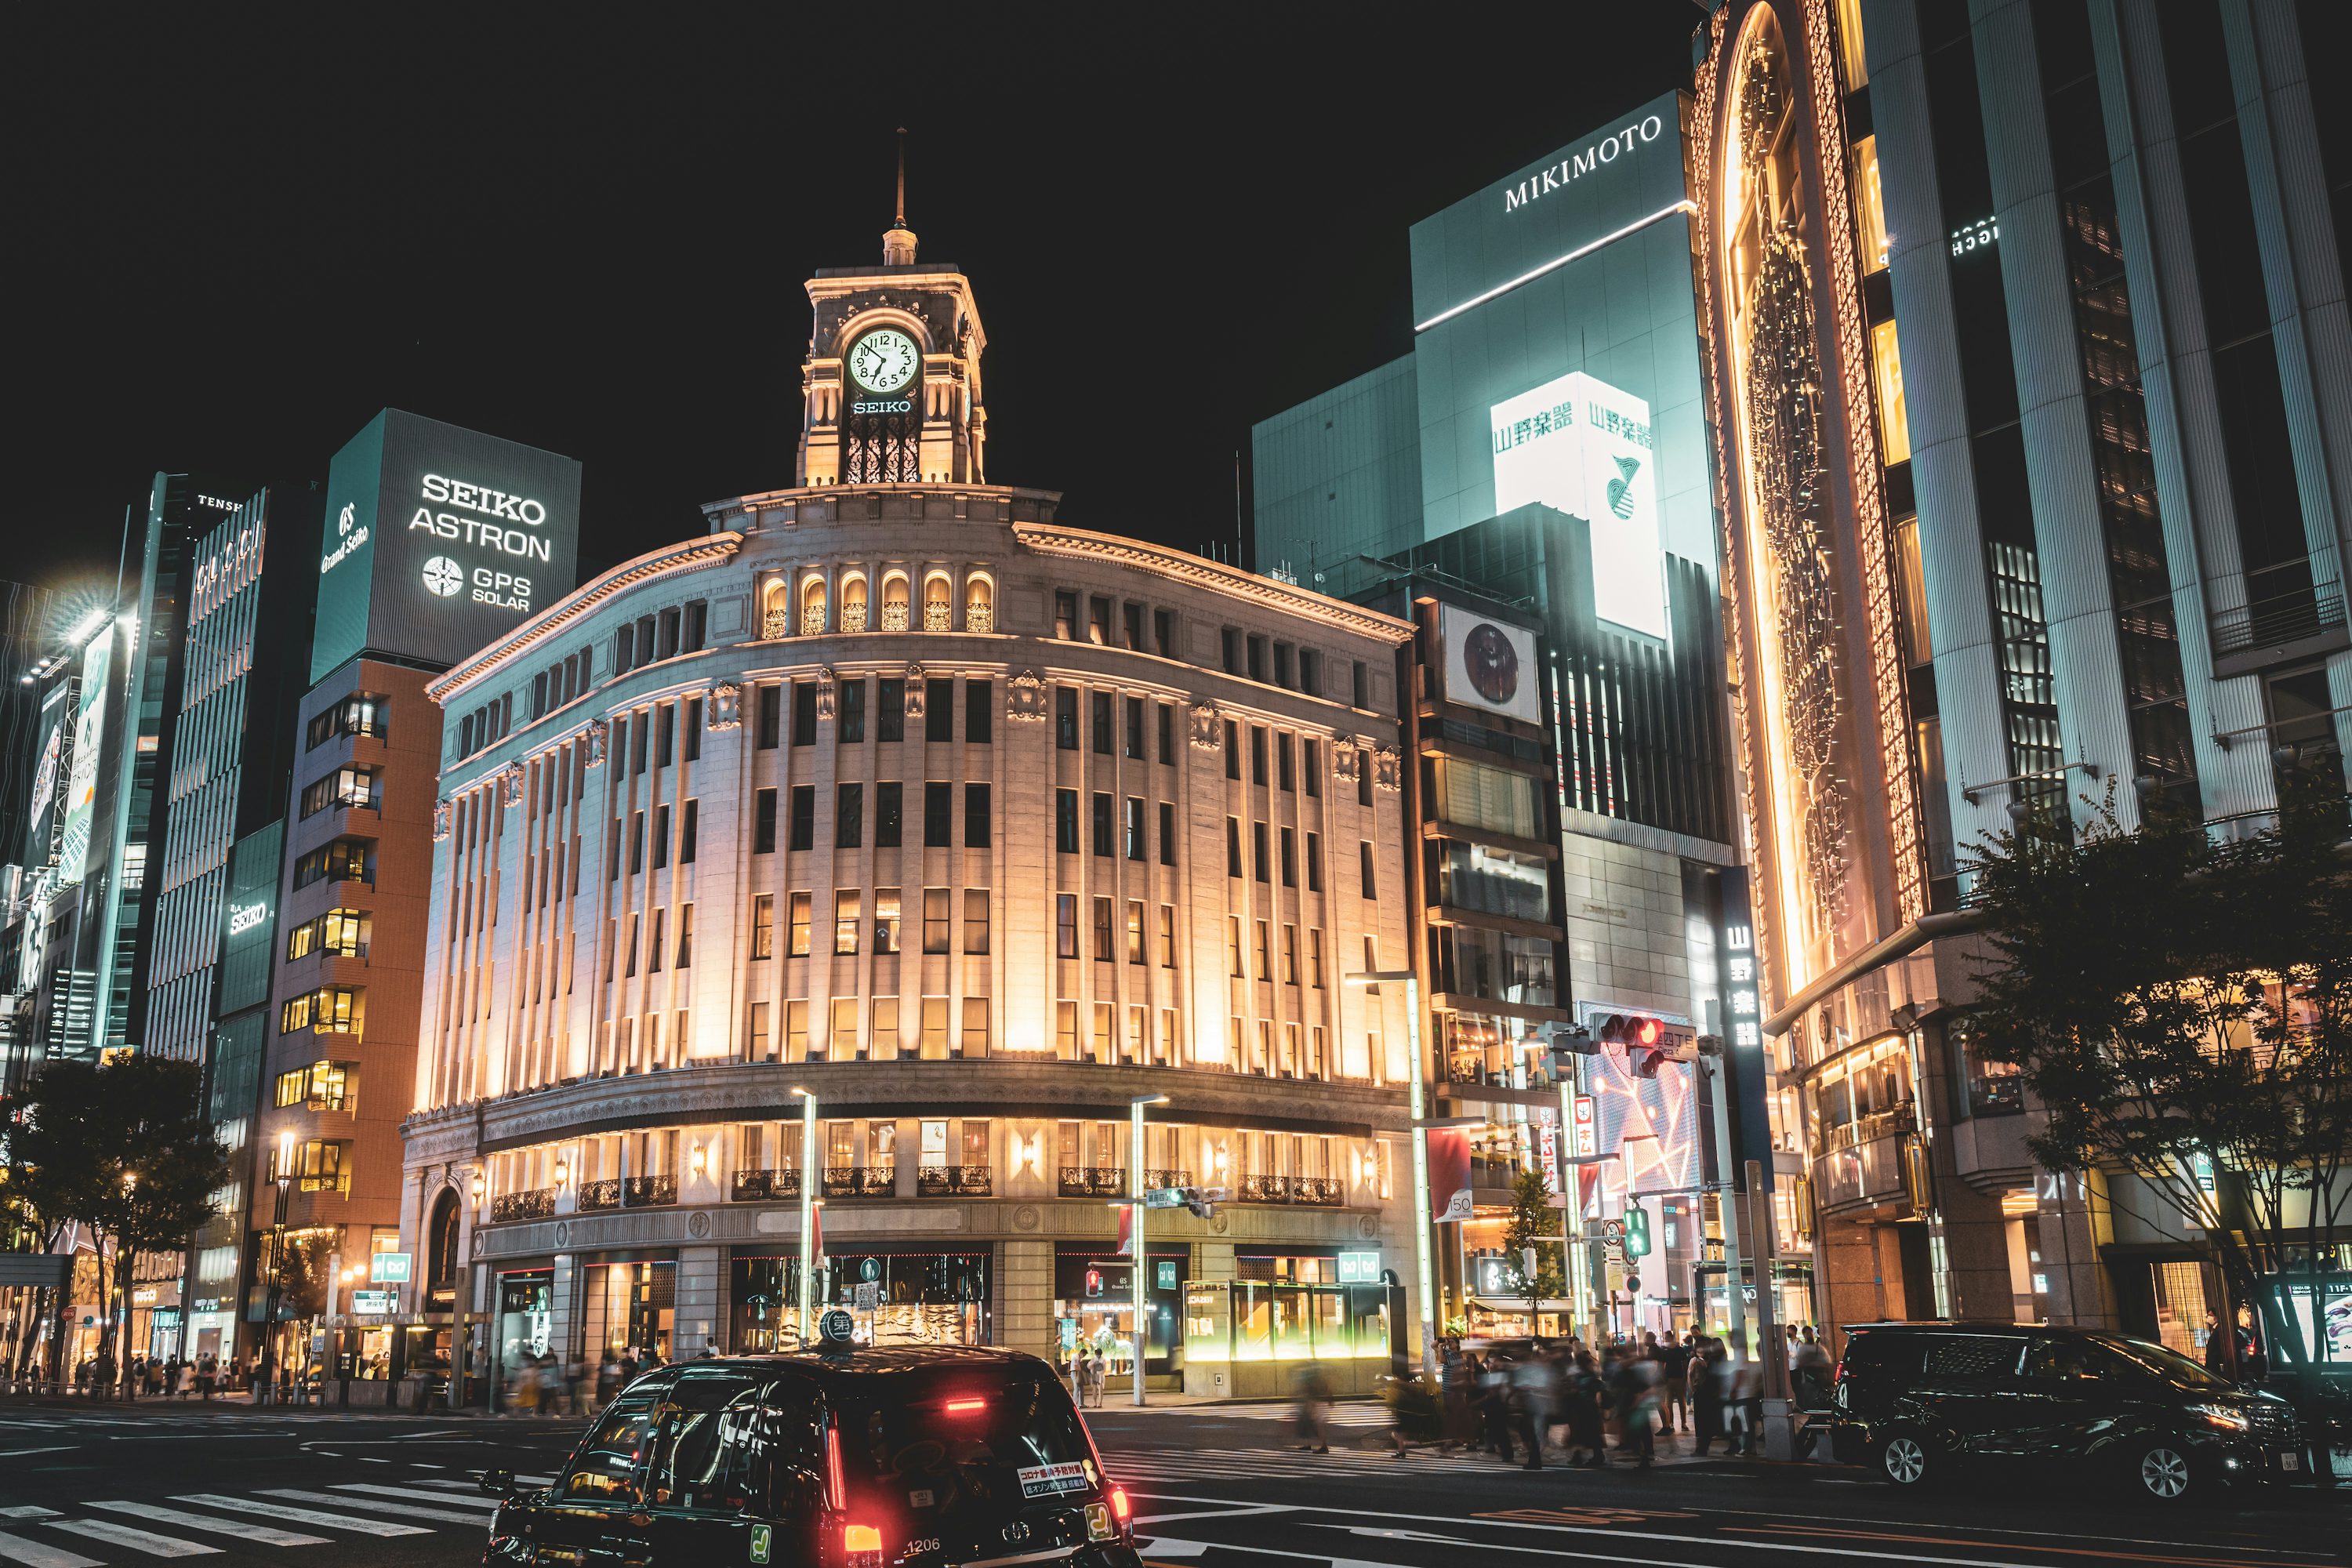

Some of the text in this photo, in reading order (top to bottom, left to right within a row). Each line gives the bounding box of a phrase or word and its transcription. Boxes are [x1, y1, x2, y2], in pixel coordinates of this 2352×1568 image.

[1505, 116, 1661, 212] MIKIMOTO
[870, 339, 877, 347] 11
[880, 336, 889, 345] 12
[894, 338, 897, 347] 1
[860, 347, 869, 356] 10
[901, 345, 908, 354] 2
[857, 358, 864, 367] 9
[904, 356, 911, 365] 3
[860, 368, 868, 377] 8
[899, 367, 907, 376] 4
[870, 376, 877, 384] 7
[880, 378, 887, 387] 6
[891, 375, 898, 384] 5
[854, 401, 911, 414] SEIKO
[1493, 401, 1573, 455] 山野楽器
[1589, 401, 1652, 450] 山野楽器
[422, 474, 546, 526] SEIKO
[339, 501, 355, 537] GS
[408, 507, 550, 562] ASTRON
[321, 524, 369, 574] Grand Seiko
[196, 520, 260, 593] GUCCI
[473, 567, 532, 597] GPS
[472, 588, 530, 612] SOLAR
[230, 902, 266, 935] SEIKO
[1727, 926, 1758, 1046] 山野楽器
[1450, 1198, 1471, 1211] 150
[1020, 1465, 1082, 1480] コロナ感染予防対策
[907, 1537, 940, 1553] 1206
